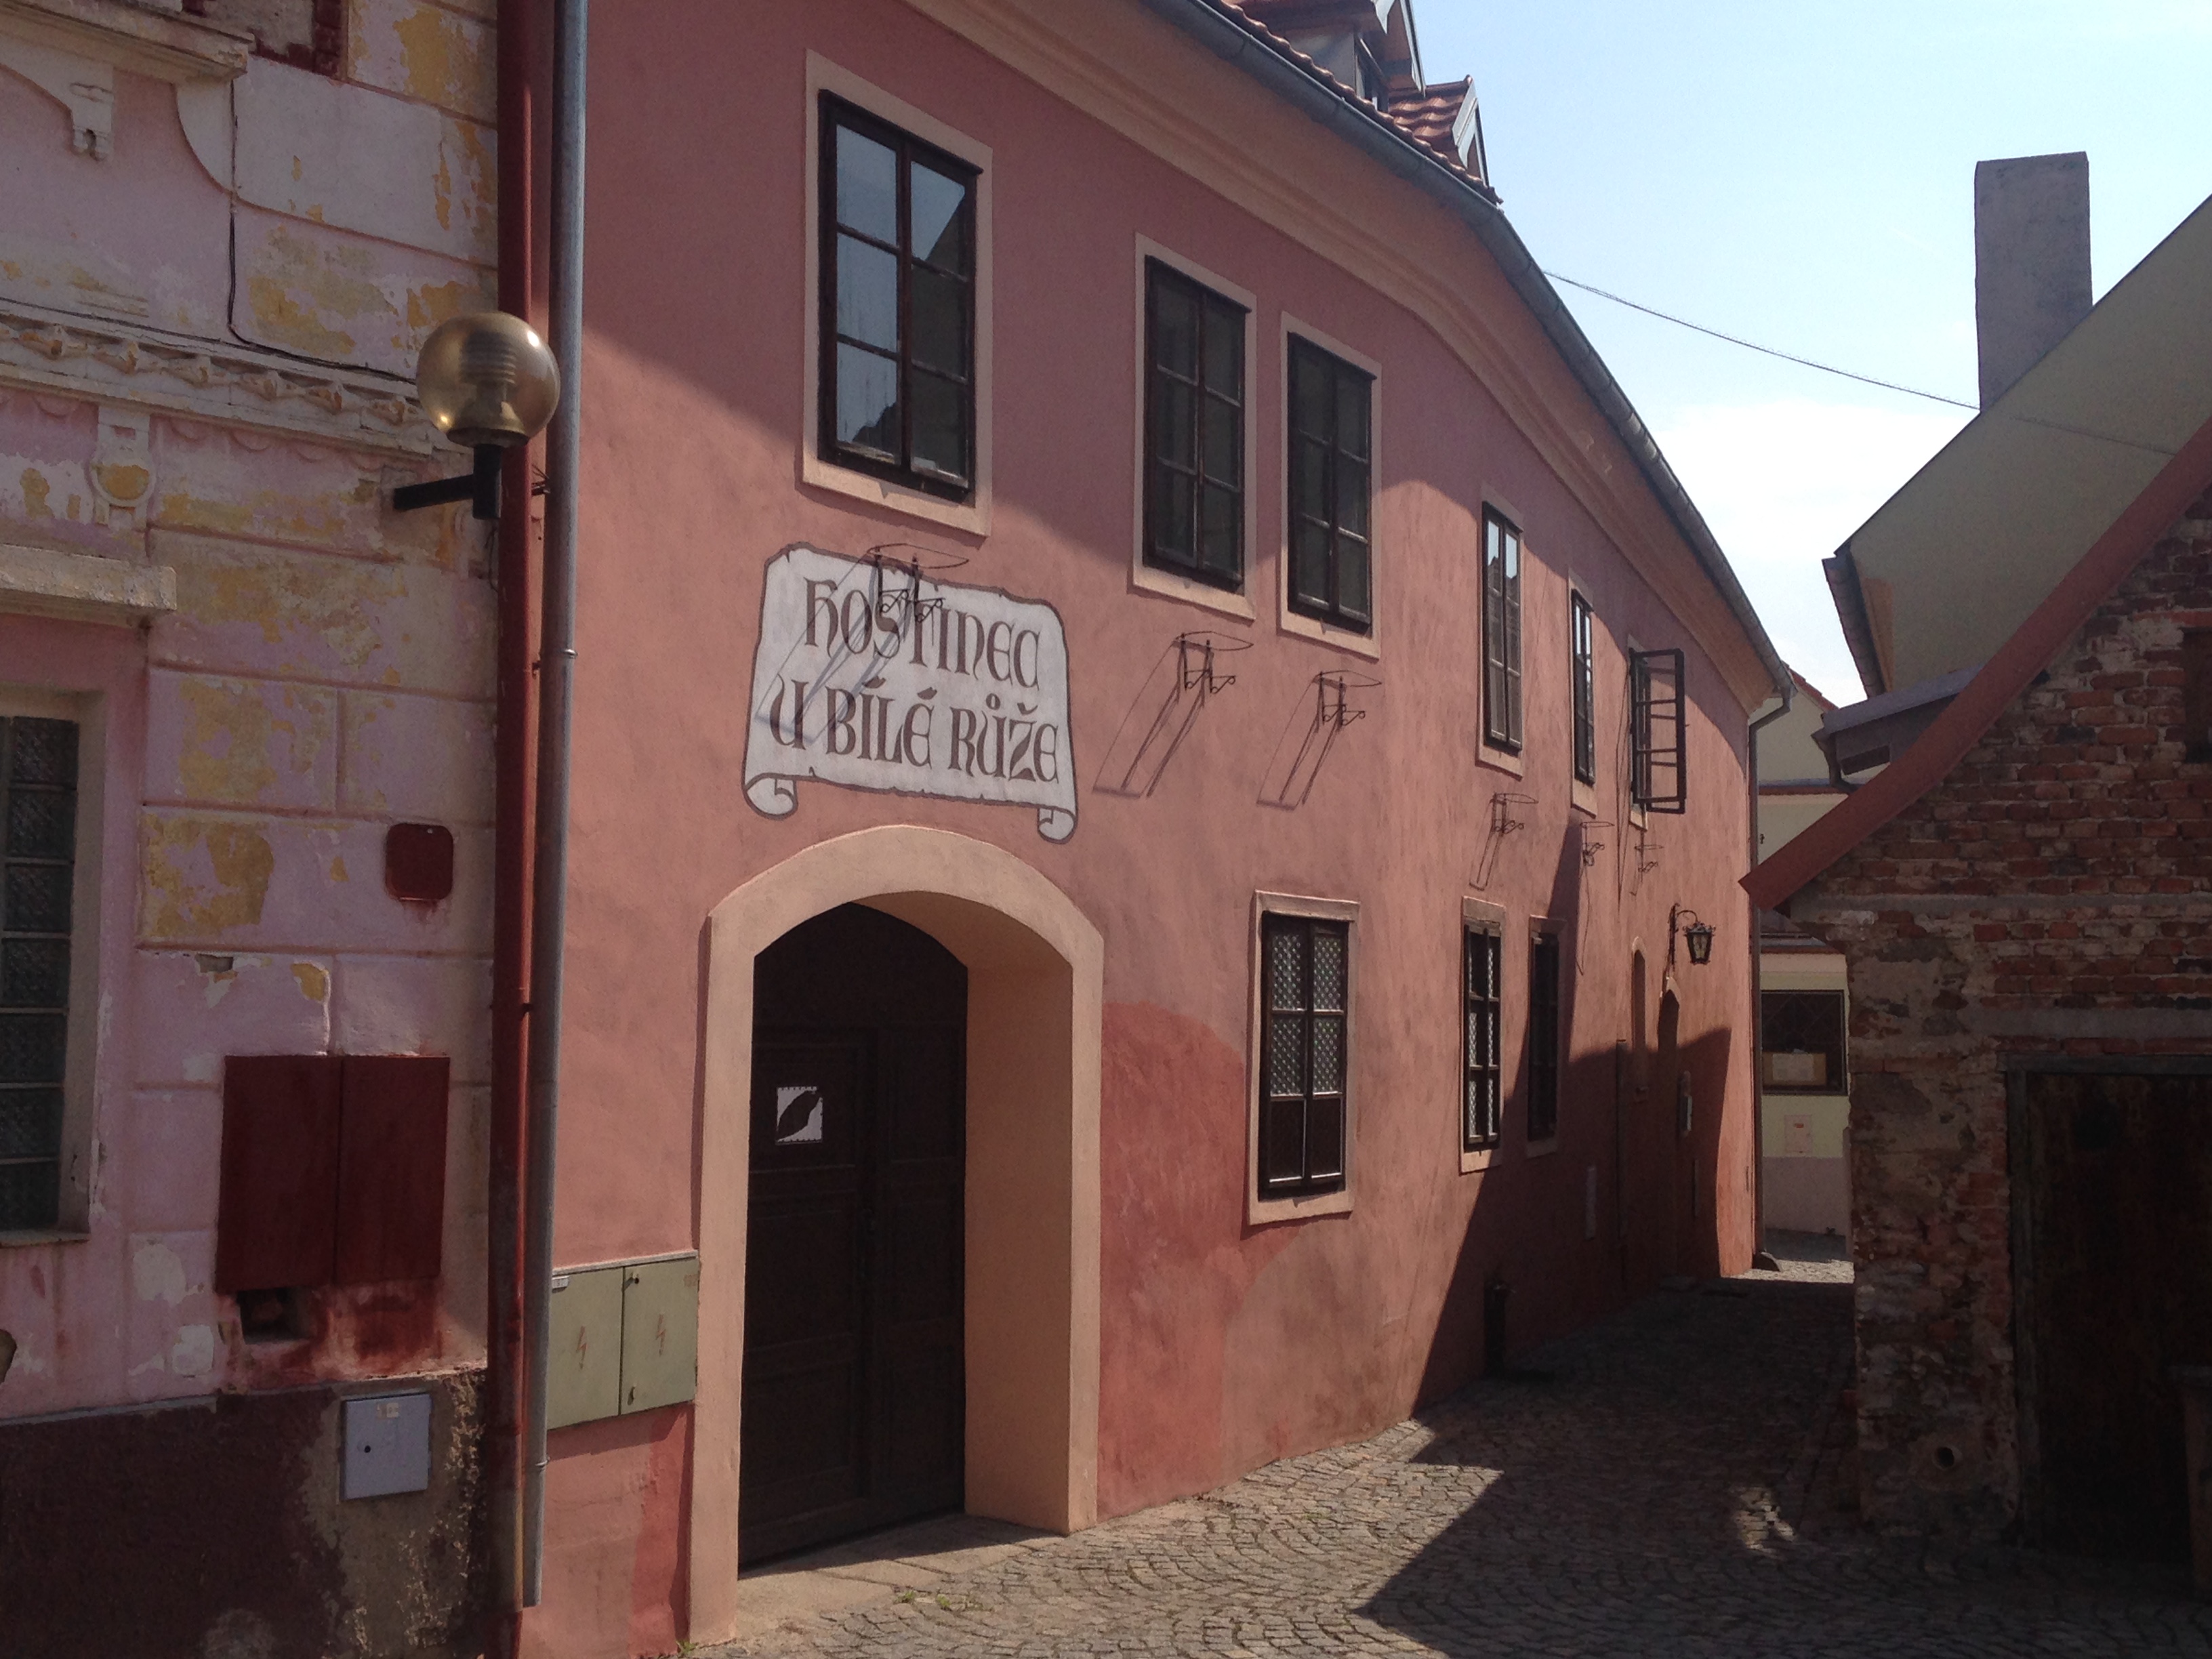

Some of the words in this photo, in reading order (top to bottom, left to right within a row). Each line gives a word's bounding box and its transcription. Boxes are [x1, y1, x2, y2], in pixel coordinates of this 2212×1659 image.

[769, 674, 810, 750] U
[825, 675, 937, 769] BÍLÉ
[948, 693, 1059, 783] RŮŽE
